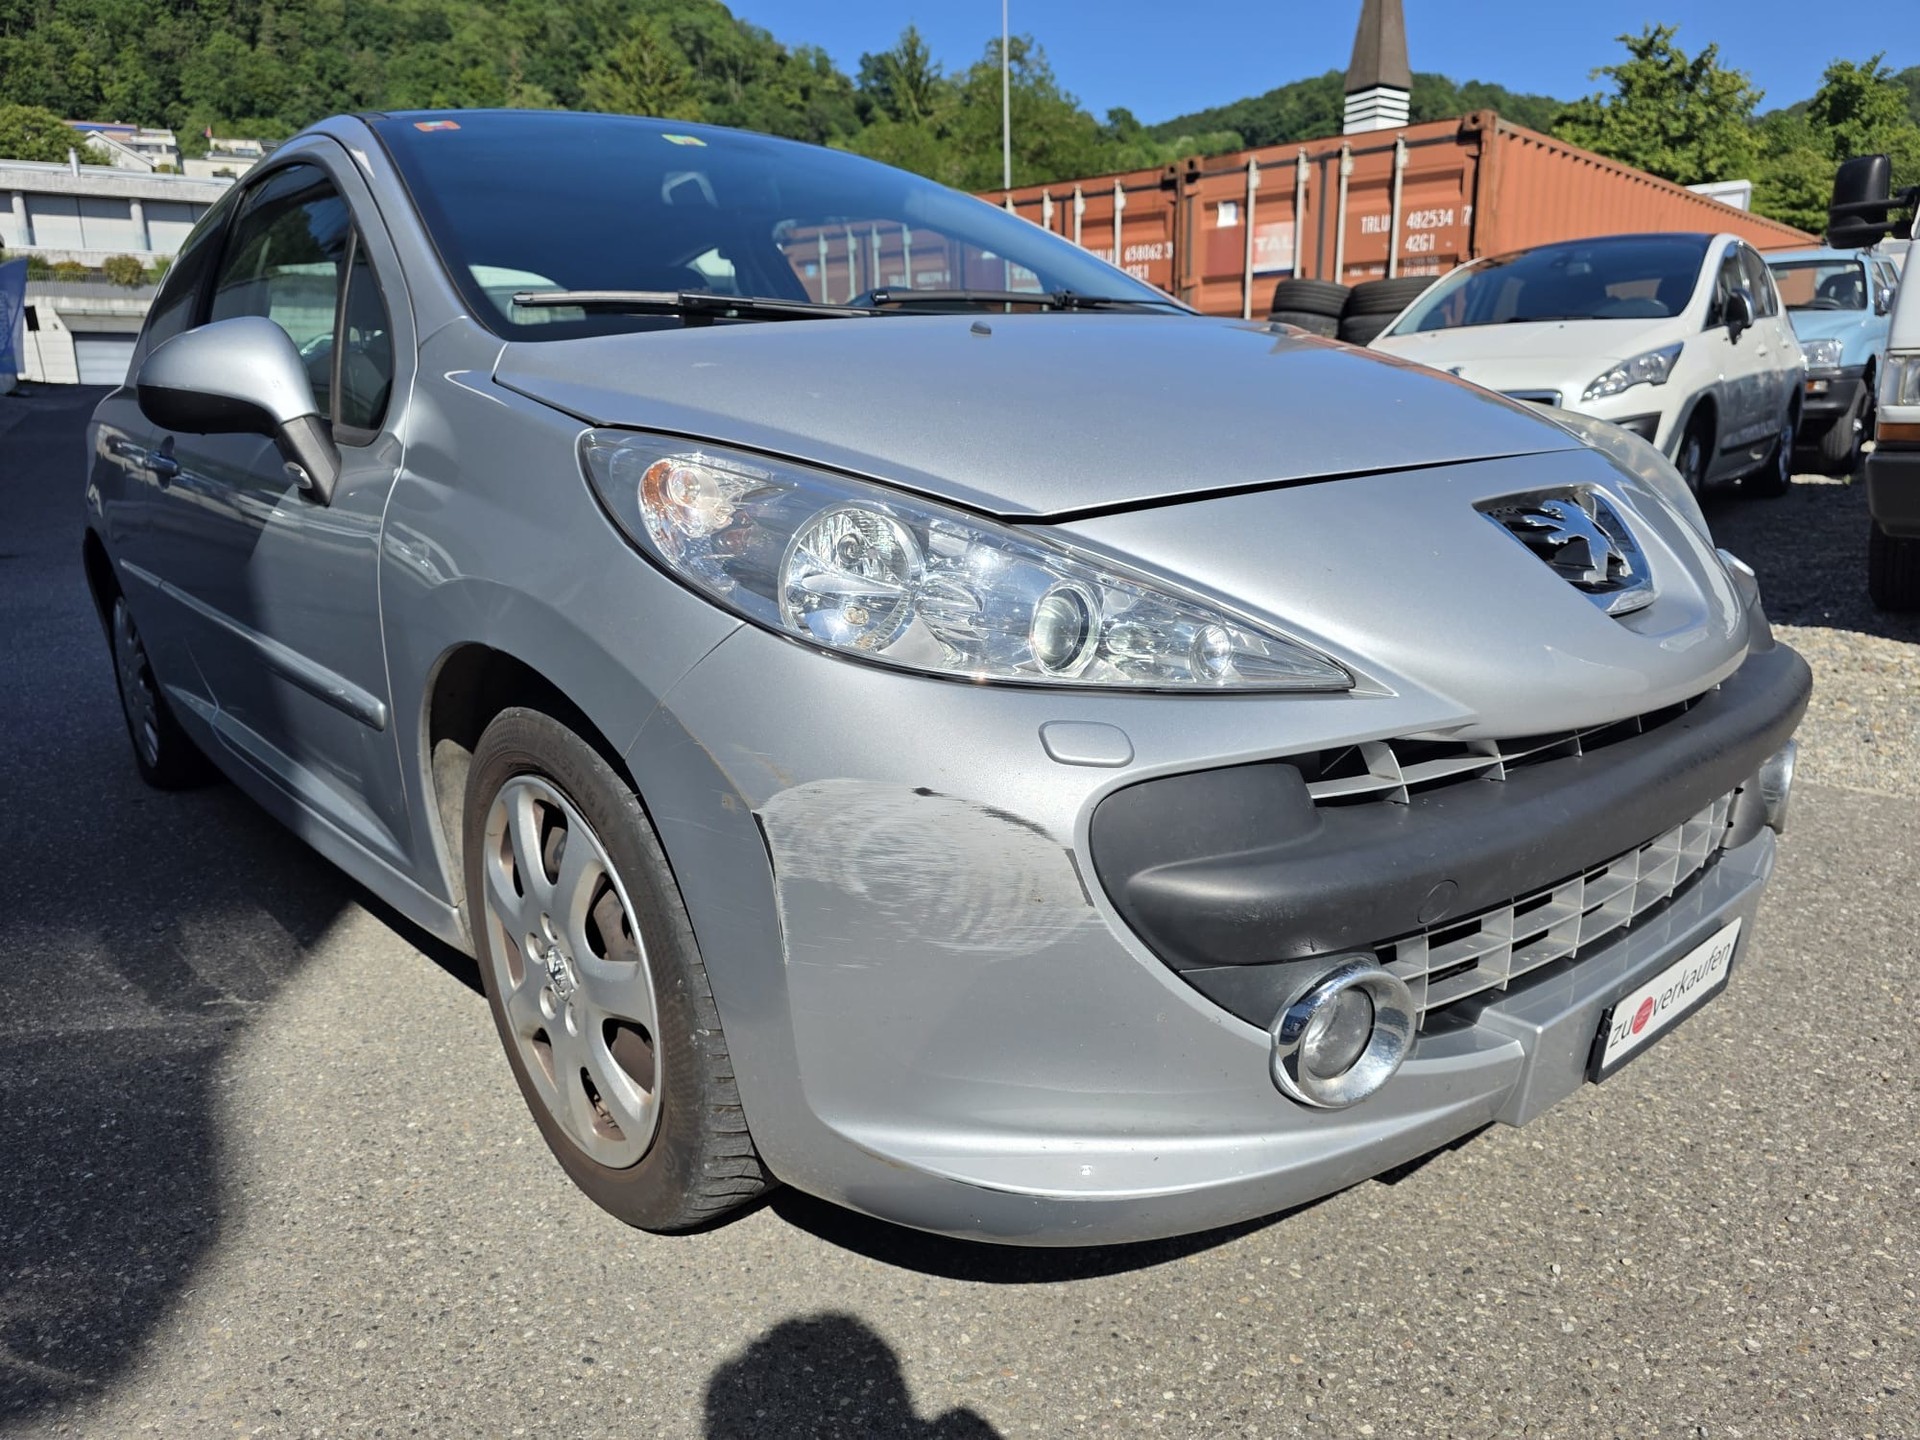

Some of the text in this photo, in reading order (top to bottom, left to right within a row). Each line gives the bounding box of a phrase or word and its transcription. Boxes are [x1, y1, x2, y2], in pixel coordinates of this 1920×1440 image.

[1406, 208, 1454, 229] 482534
[1609, 1014, 1635, 1049] zu
[1653, 943, 1731, 1016] verkaufen
